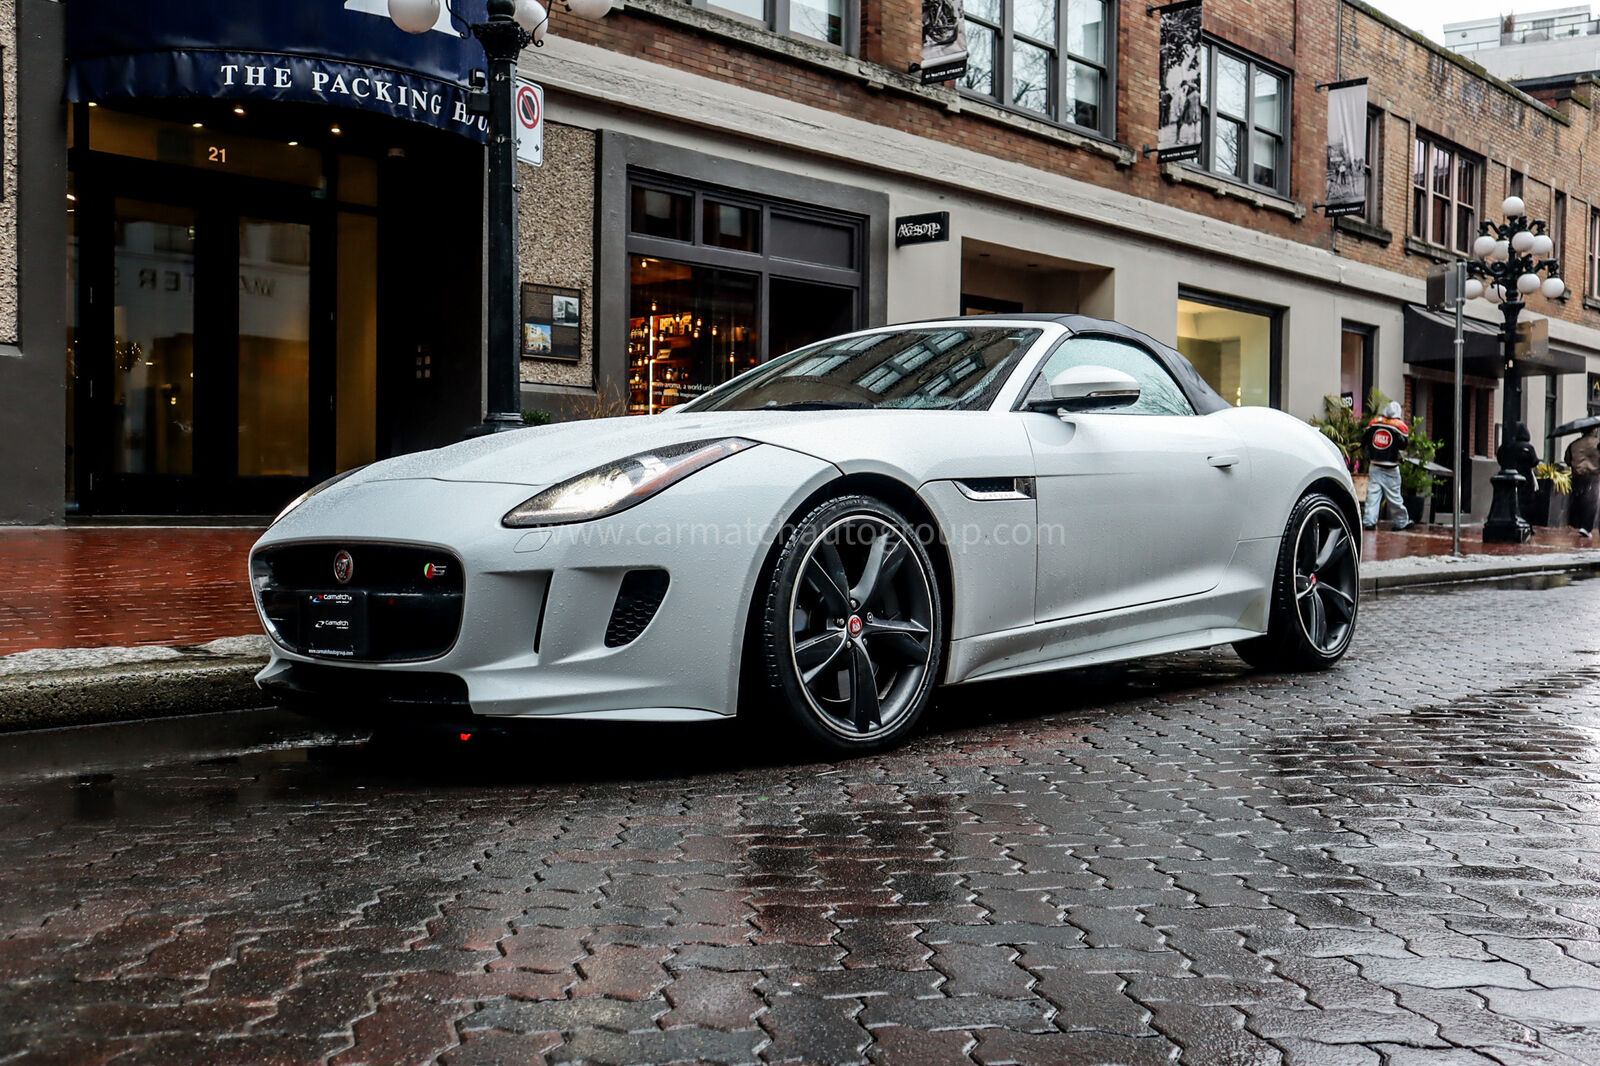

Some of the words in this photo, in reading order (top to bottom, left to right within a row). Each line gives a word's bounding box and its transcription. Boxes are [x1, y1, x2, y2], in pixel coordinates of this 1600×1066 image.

[221, 65, 292, 88] THE
[312, 71, 443, 115] PACKING
[208, 146, 226, 163] 21
